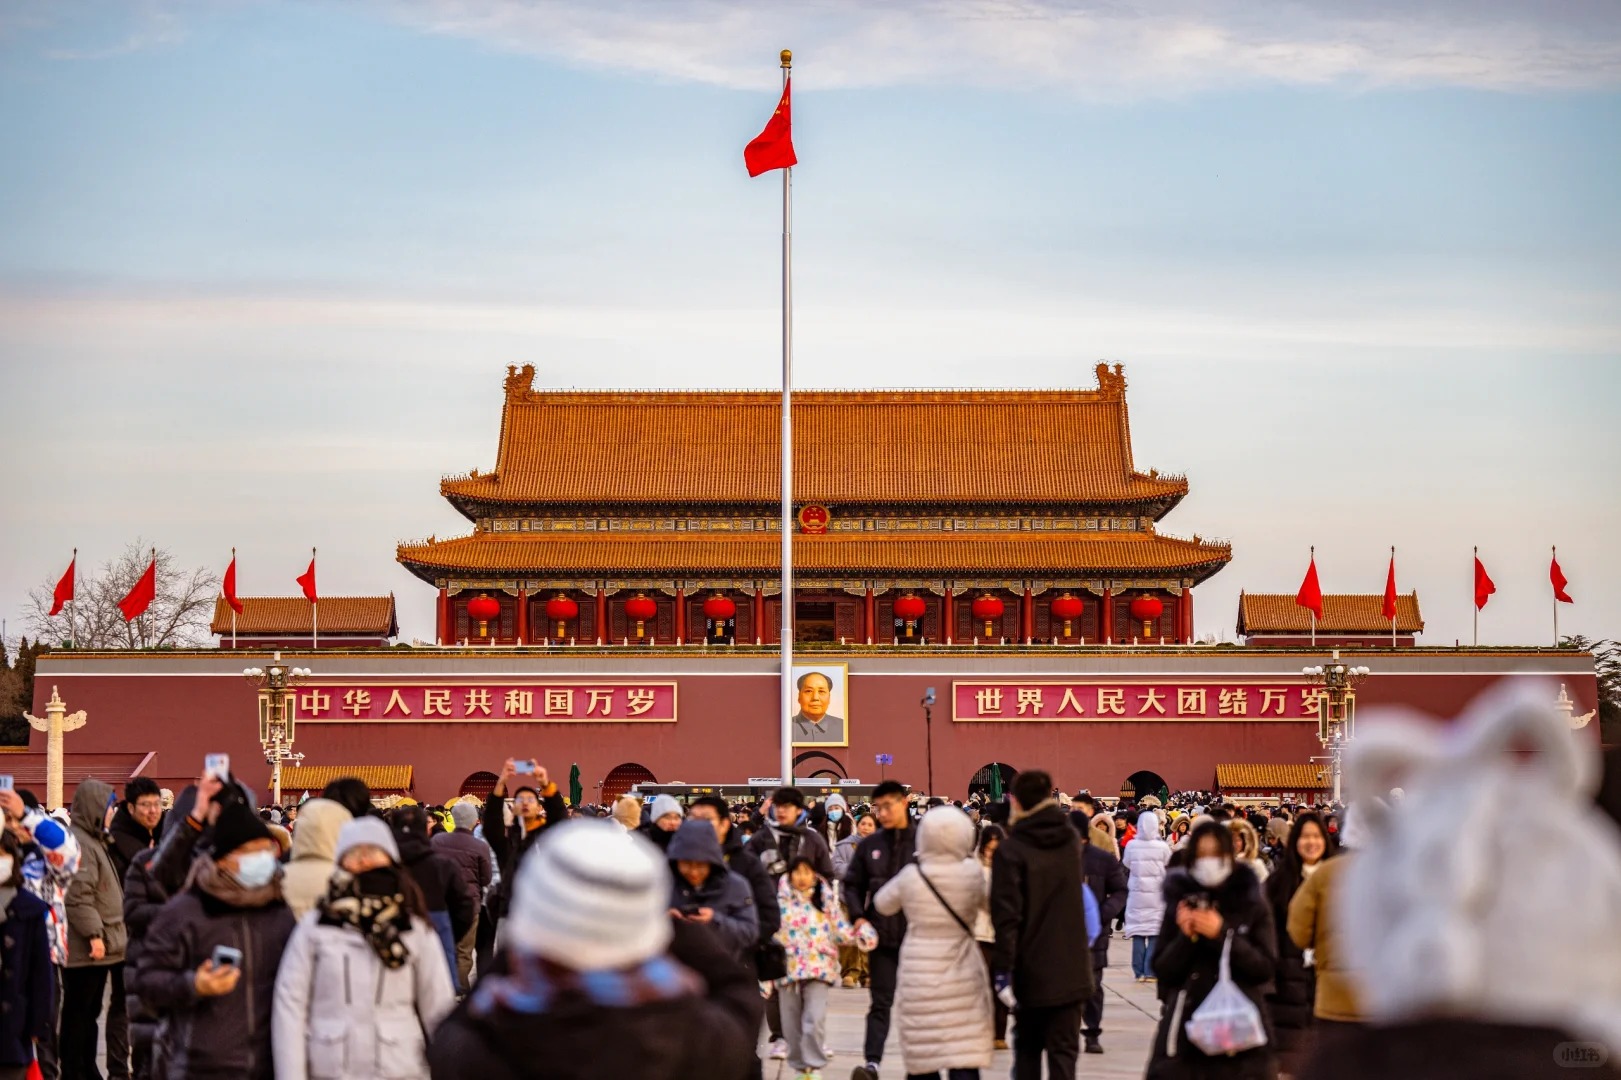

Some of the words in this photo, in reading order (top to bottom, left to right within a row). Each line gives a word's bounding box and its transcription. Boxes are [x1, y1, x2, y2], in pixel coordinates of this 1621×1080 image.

[301, 688, 655, 715] 中华人民共和国万岁
[974, 688, 1320, 715] 世界人民大团结万岁
